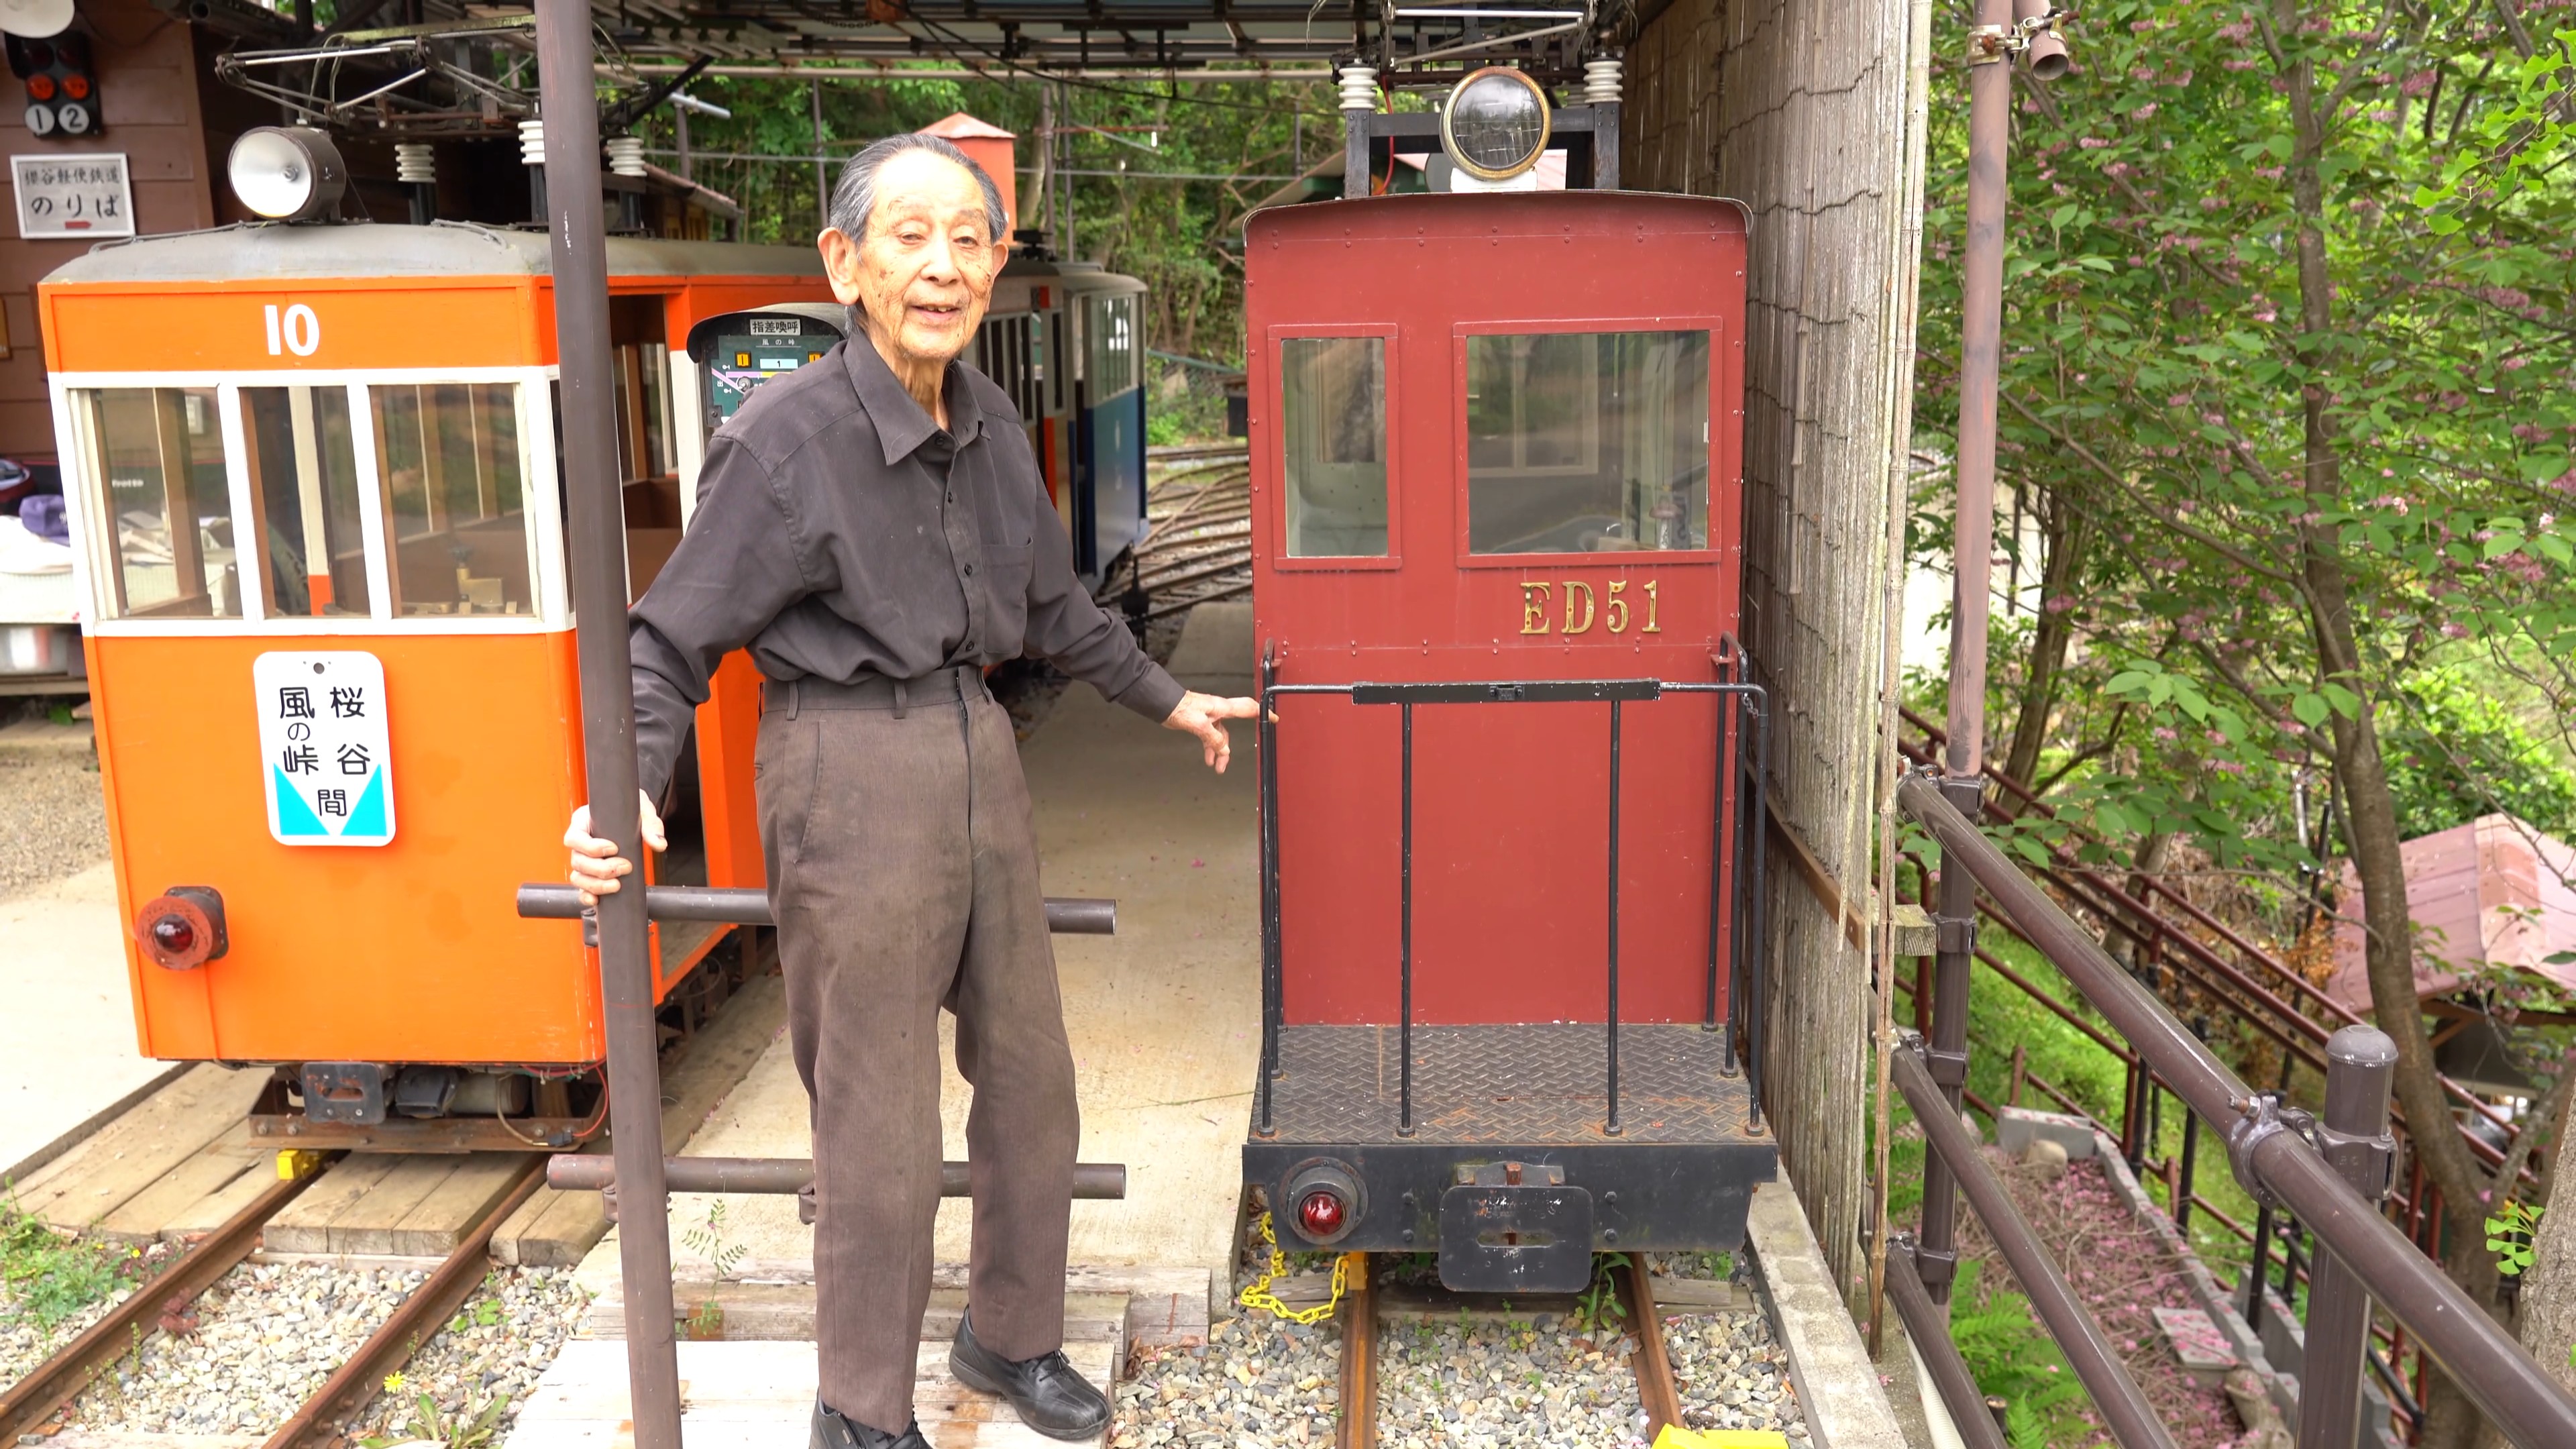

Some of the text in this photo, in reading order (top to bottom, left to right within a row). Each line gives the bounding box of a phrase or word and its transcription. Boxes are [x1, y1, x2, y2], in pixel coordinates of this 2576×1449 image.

[36, 108, 42, 130] 1
[66, 108, 82, 128] 2
[32, 194, 119, 219] のりば
[264, 303, 320, 356] 10
[753, 321, 798, 333] 指差喚呼
[1519, 580, 1661, 634] ED51
[279, 686, 319, 775] 風の峠
[317, 789, 347, 816] 間
